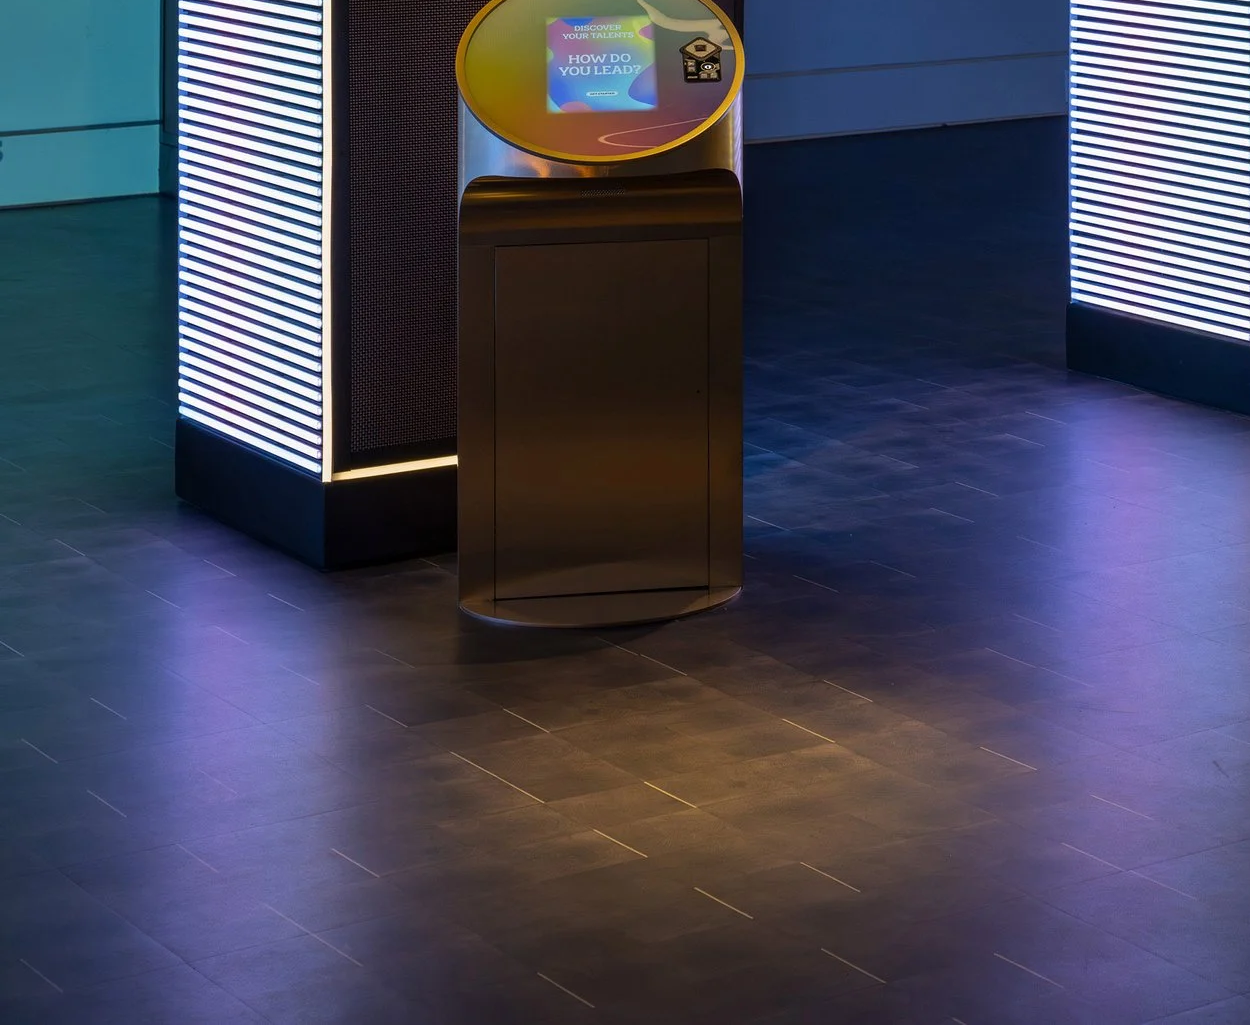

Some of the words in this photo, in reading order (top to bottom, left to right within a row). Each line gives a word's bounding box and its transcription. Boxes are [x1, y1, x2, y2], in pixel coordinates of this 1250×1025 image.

[574, 24, 622, 32] DISCOVER
[563, 32, 589, 40] YOUR
[590, 31, 634, 39] TALENTS
[568, 54, 607, 64] HOW
[610, 53, 631, 63] DO
[559, 65, 591, 77] YOU
[594, 65, 641, 76] LEAD?
